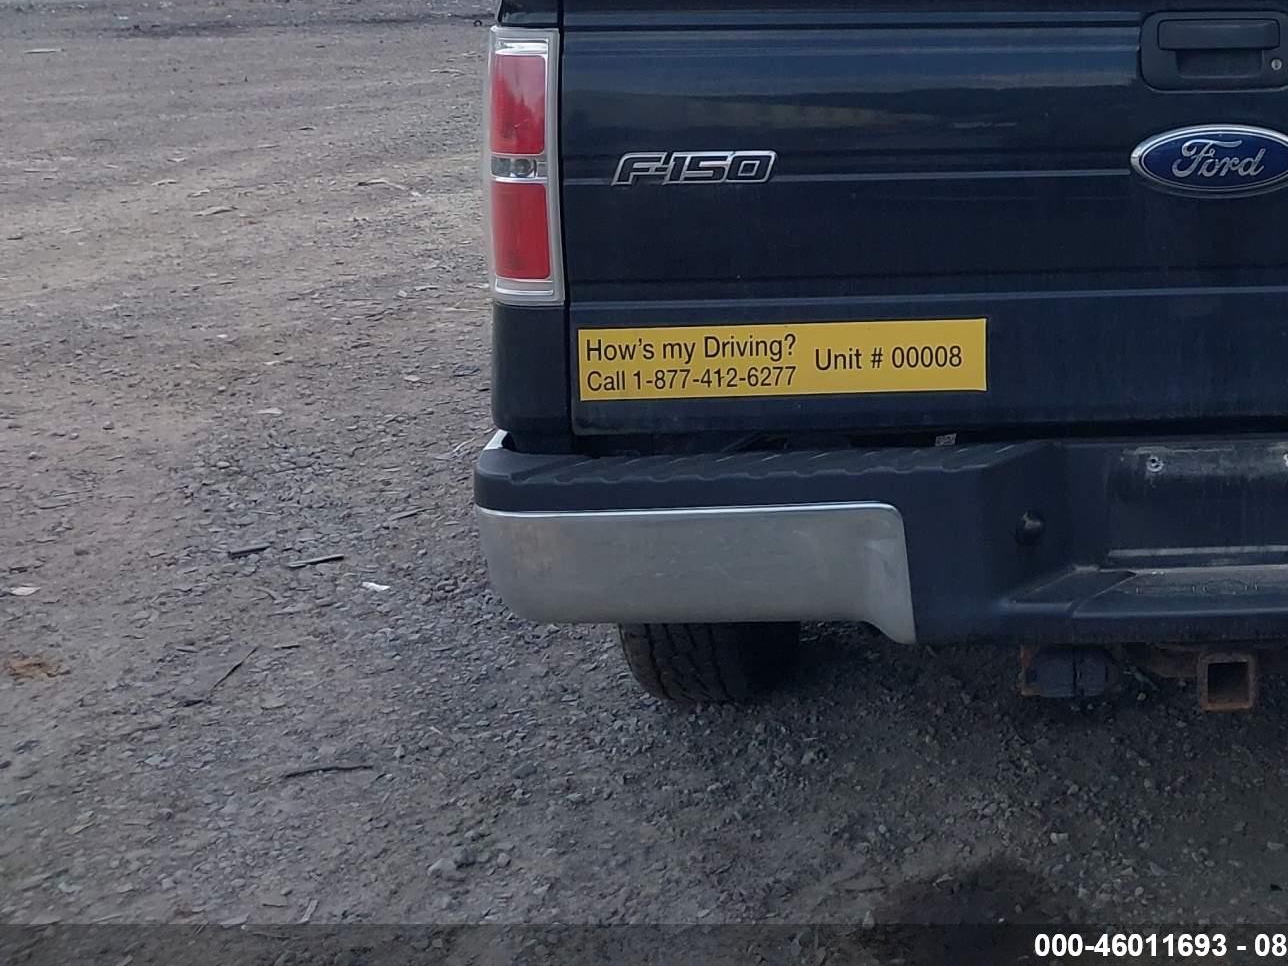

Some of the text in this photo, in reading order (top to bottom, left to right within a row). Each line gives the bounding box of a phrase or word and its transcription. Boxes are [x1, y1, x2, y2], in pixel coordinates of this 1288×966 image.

[611, 151, 777, 186] F-150
[1172, 139, 1266, 178] Ford
[586, 334, 797, 365] How's my Driving?
[814, 345, 963, 371] Unit # 00008
[586, 365, 797, 392] Call 1-877-412-6277
